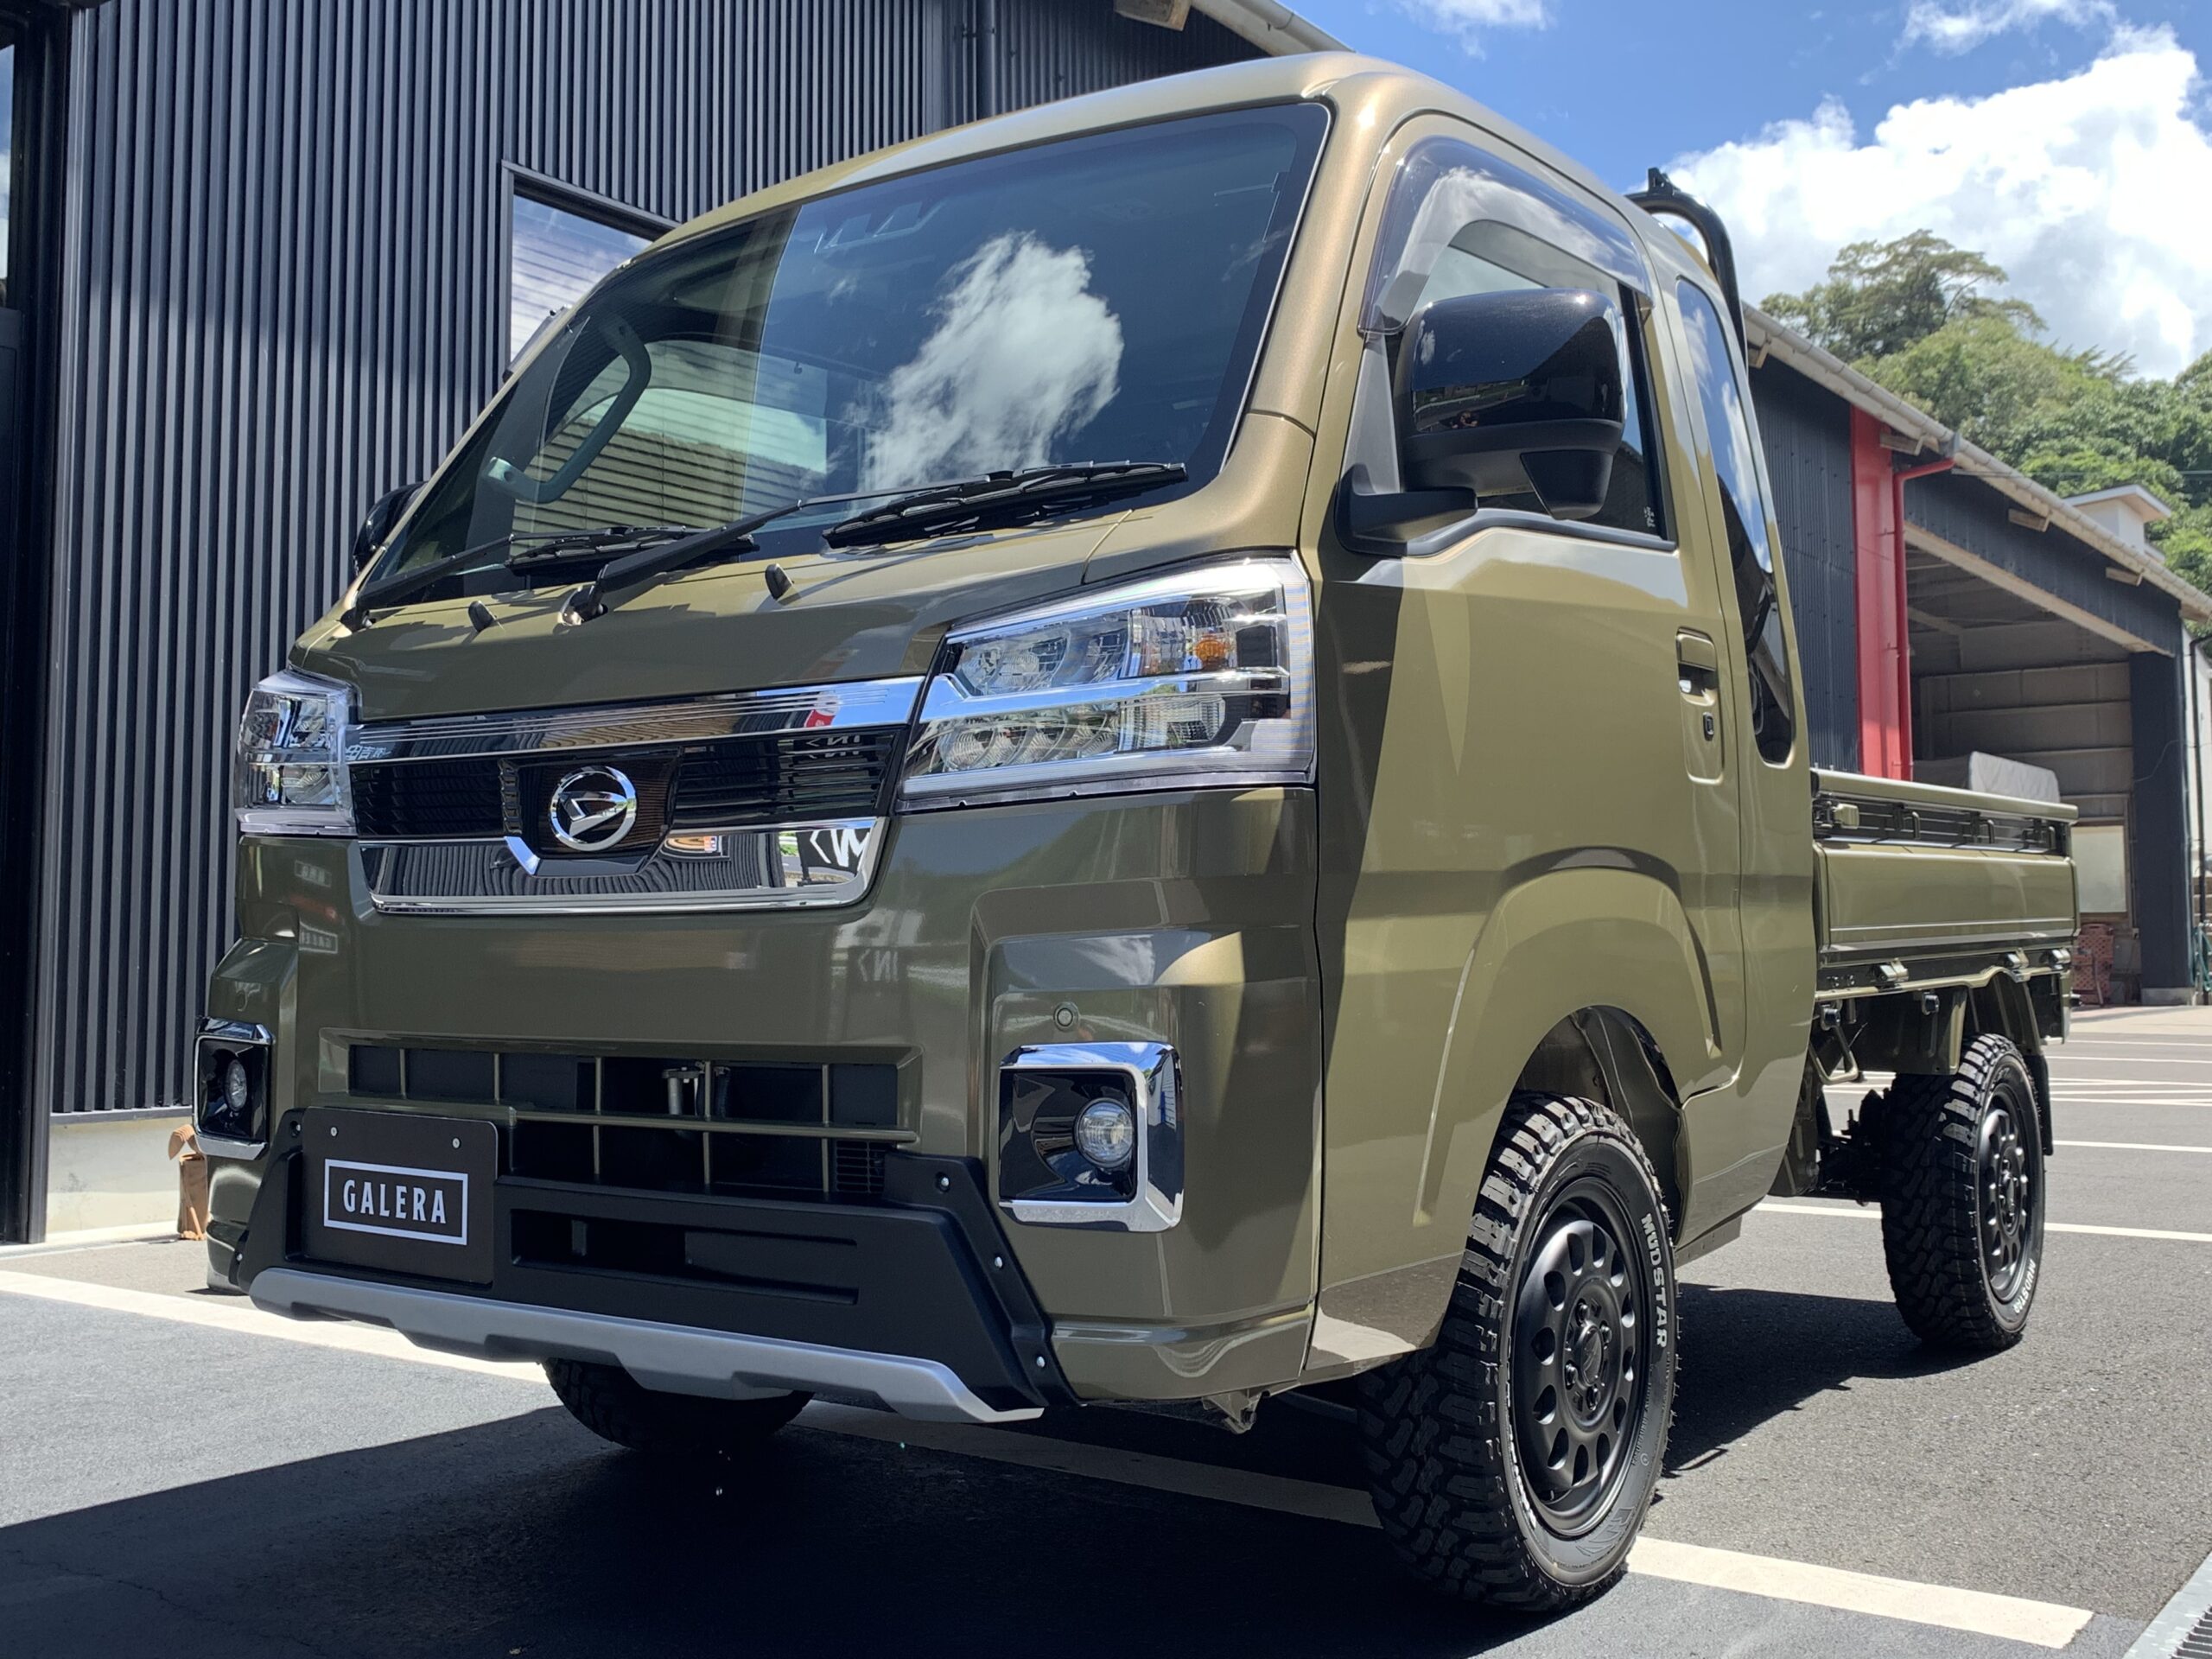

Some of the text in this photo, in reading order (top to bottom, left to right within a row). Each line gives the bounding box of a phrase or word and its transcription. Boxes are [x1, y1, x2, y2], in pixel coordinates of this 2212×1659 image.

[343, 1179, 446, 1224] GALERA
[1642, 1213, 1668, 1347] MUDSTAR
[2013, 1258, 2036, 1313] MUDSTAR
